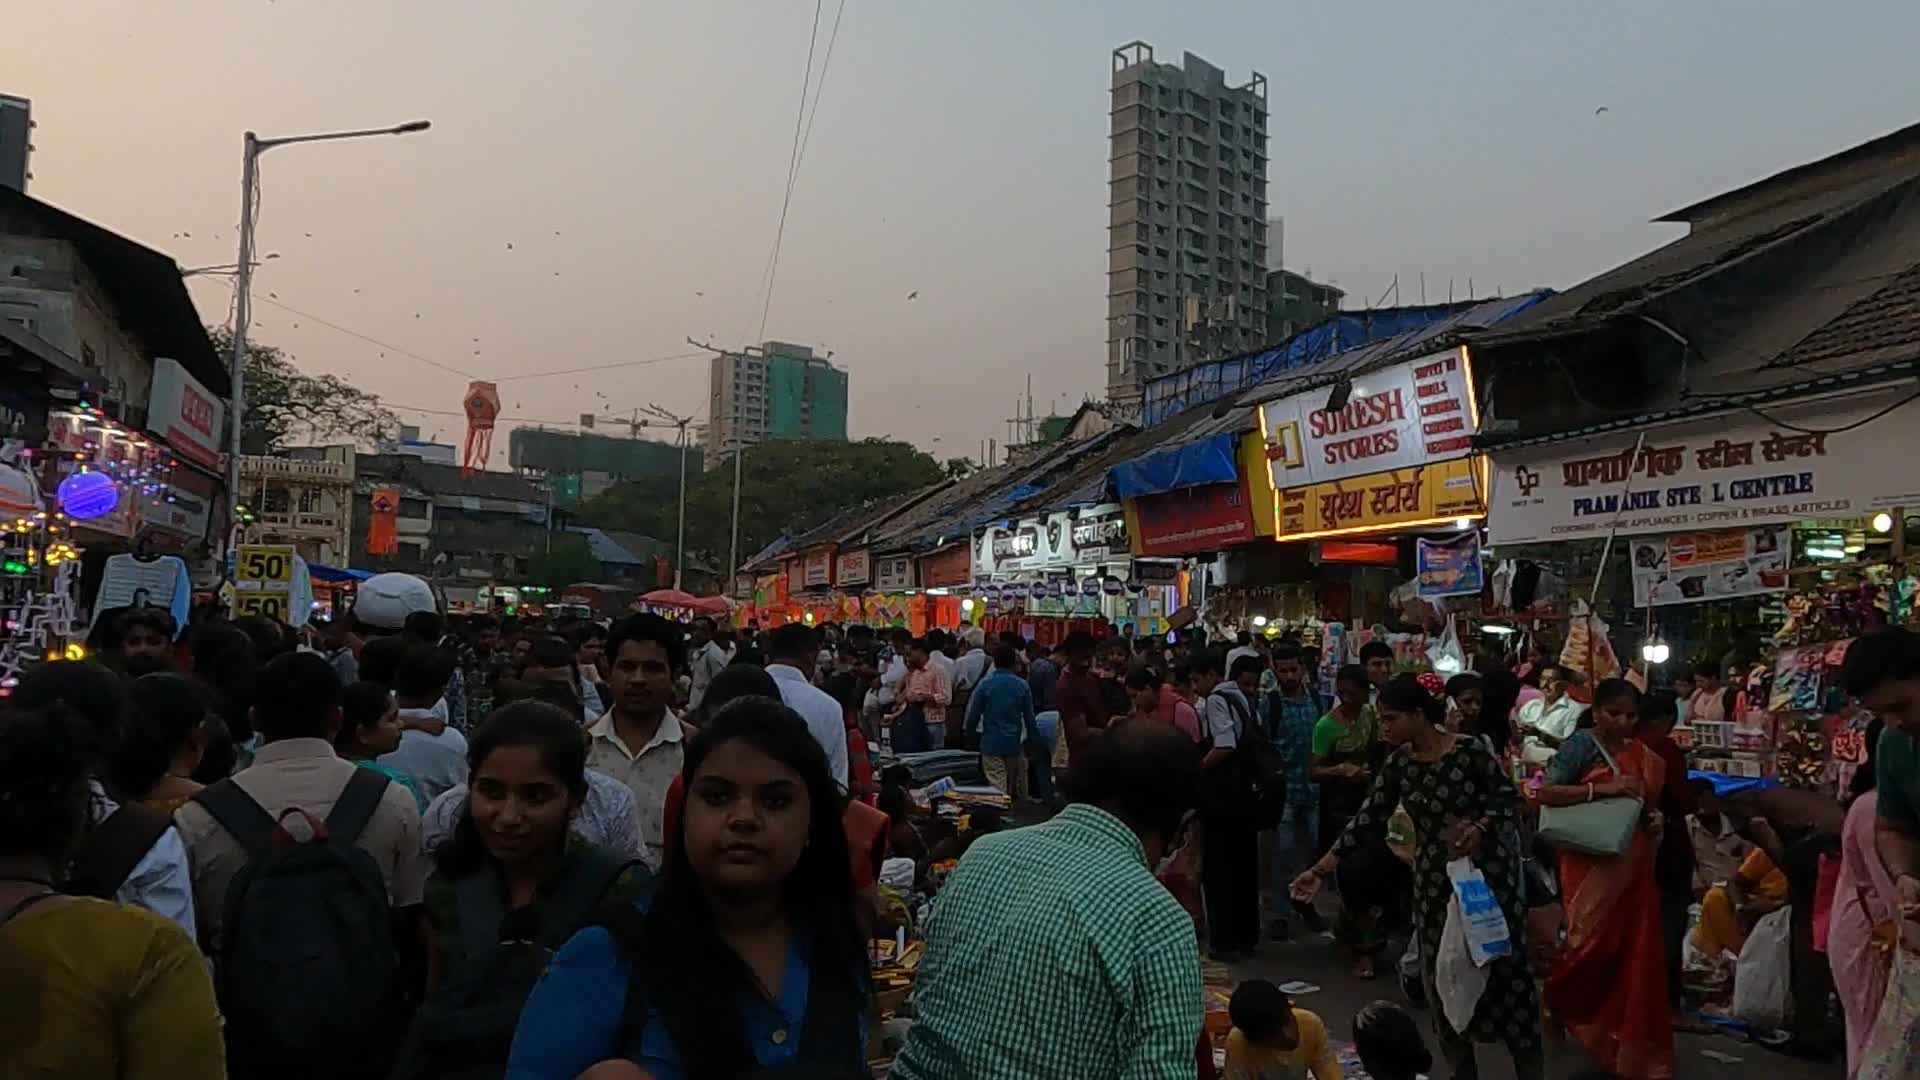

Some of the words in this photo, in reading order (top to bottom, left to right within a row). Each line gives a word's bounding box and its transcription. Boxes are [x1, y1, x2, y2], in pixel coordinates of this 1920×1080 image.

[1310, 388, 1405, 438] SURESH
[1324, 429, 1399, 464] STORES
[1573, 489, 1660, 516] PRAMANIK
[1730, 472, 1813, 501] CENTRE
[1630, 514, 1689, 528] APPLIANCES
[1792, 500, 1851, 514] ARTICLES
[248, 553, 283, 578] 50
[243, 598, 279, 620] 50
